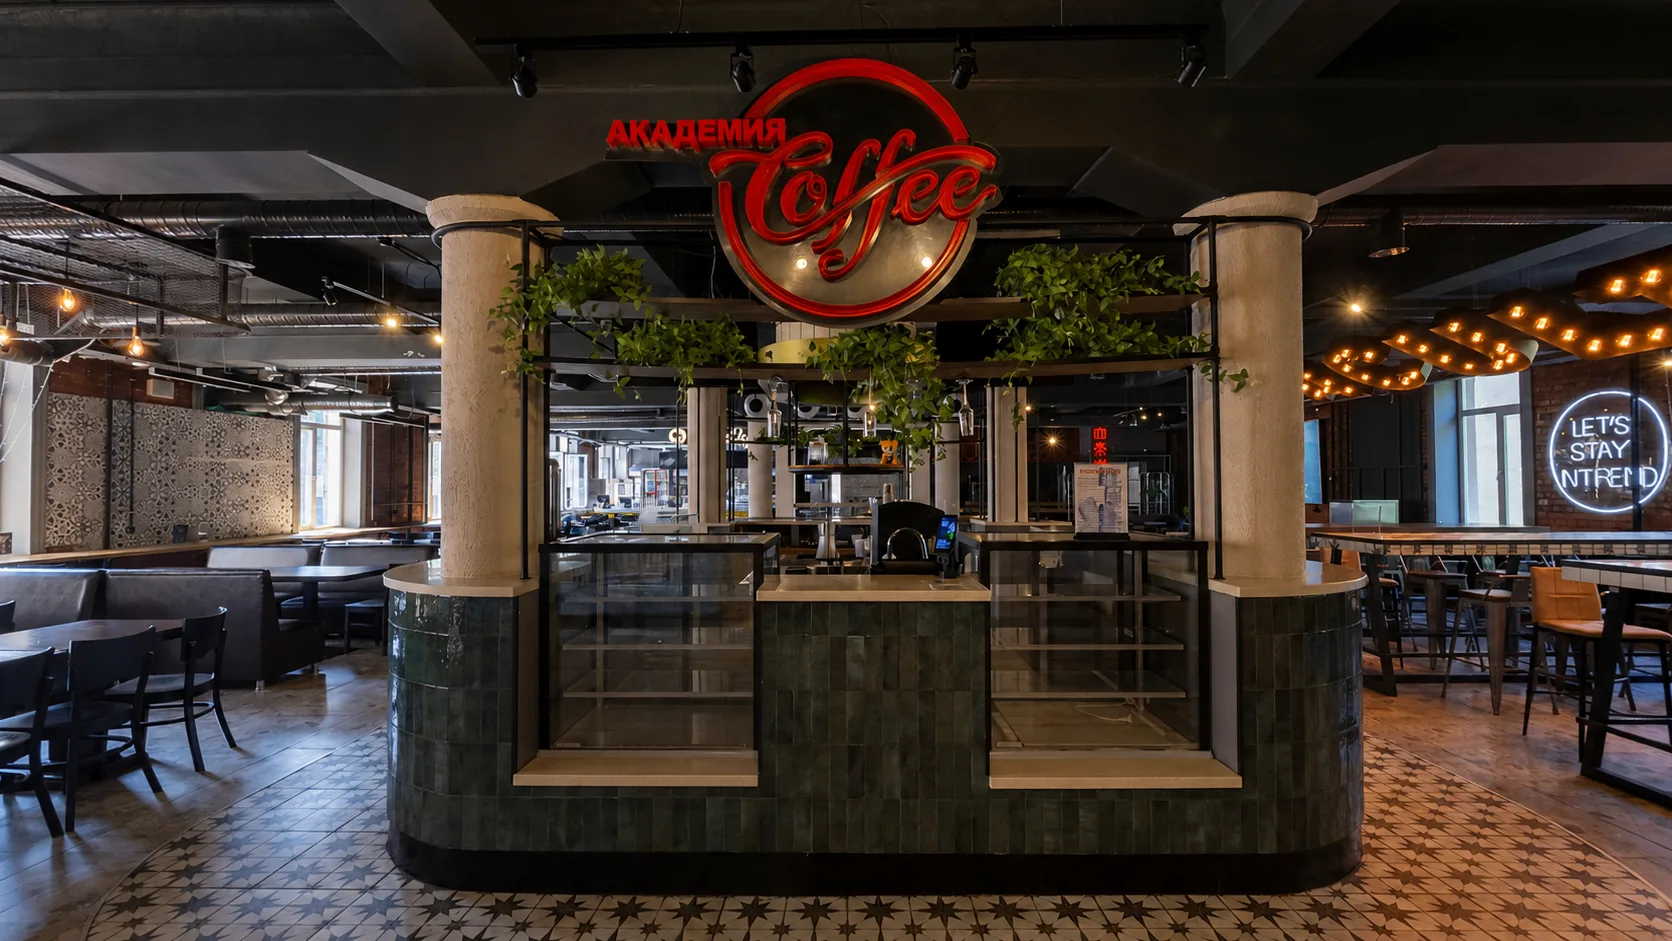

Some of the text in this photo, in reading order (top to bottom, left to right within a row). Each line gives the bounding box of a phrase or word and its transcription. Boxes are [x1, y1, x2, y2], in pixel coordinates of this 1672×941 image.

[606, 118, 786, 150] АКАДЕМИЯ
[709, 128, 999, 283] Coffee
[1571, 415, 1631, 438] LET'S
[1570, 439, 1631, 462] STAY
